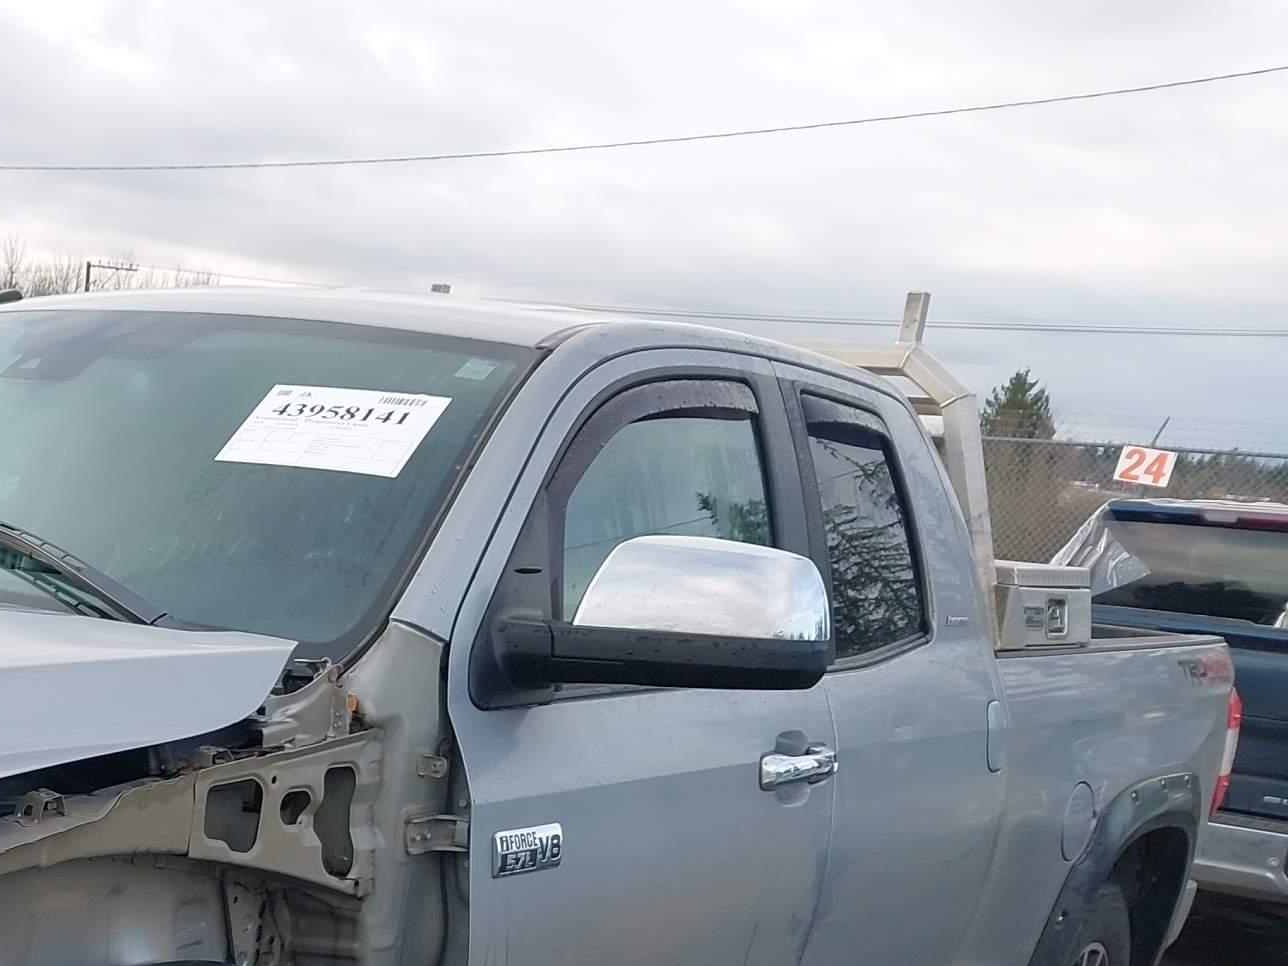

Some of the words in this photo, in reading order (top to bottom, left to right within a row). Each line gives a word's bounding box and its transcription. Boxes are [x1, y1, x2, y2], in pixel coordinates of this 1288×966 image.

[272, 402, 410, 425] 43958141
[1119, 448, 1169, 484] 24
[537, 833, 561, 861] V8
